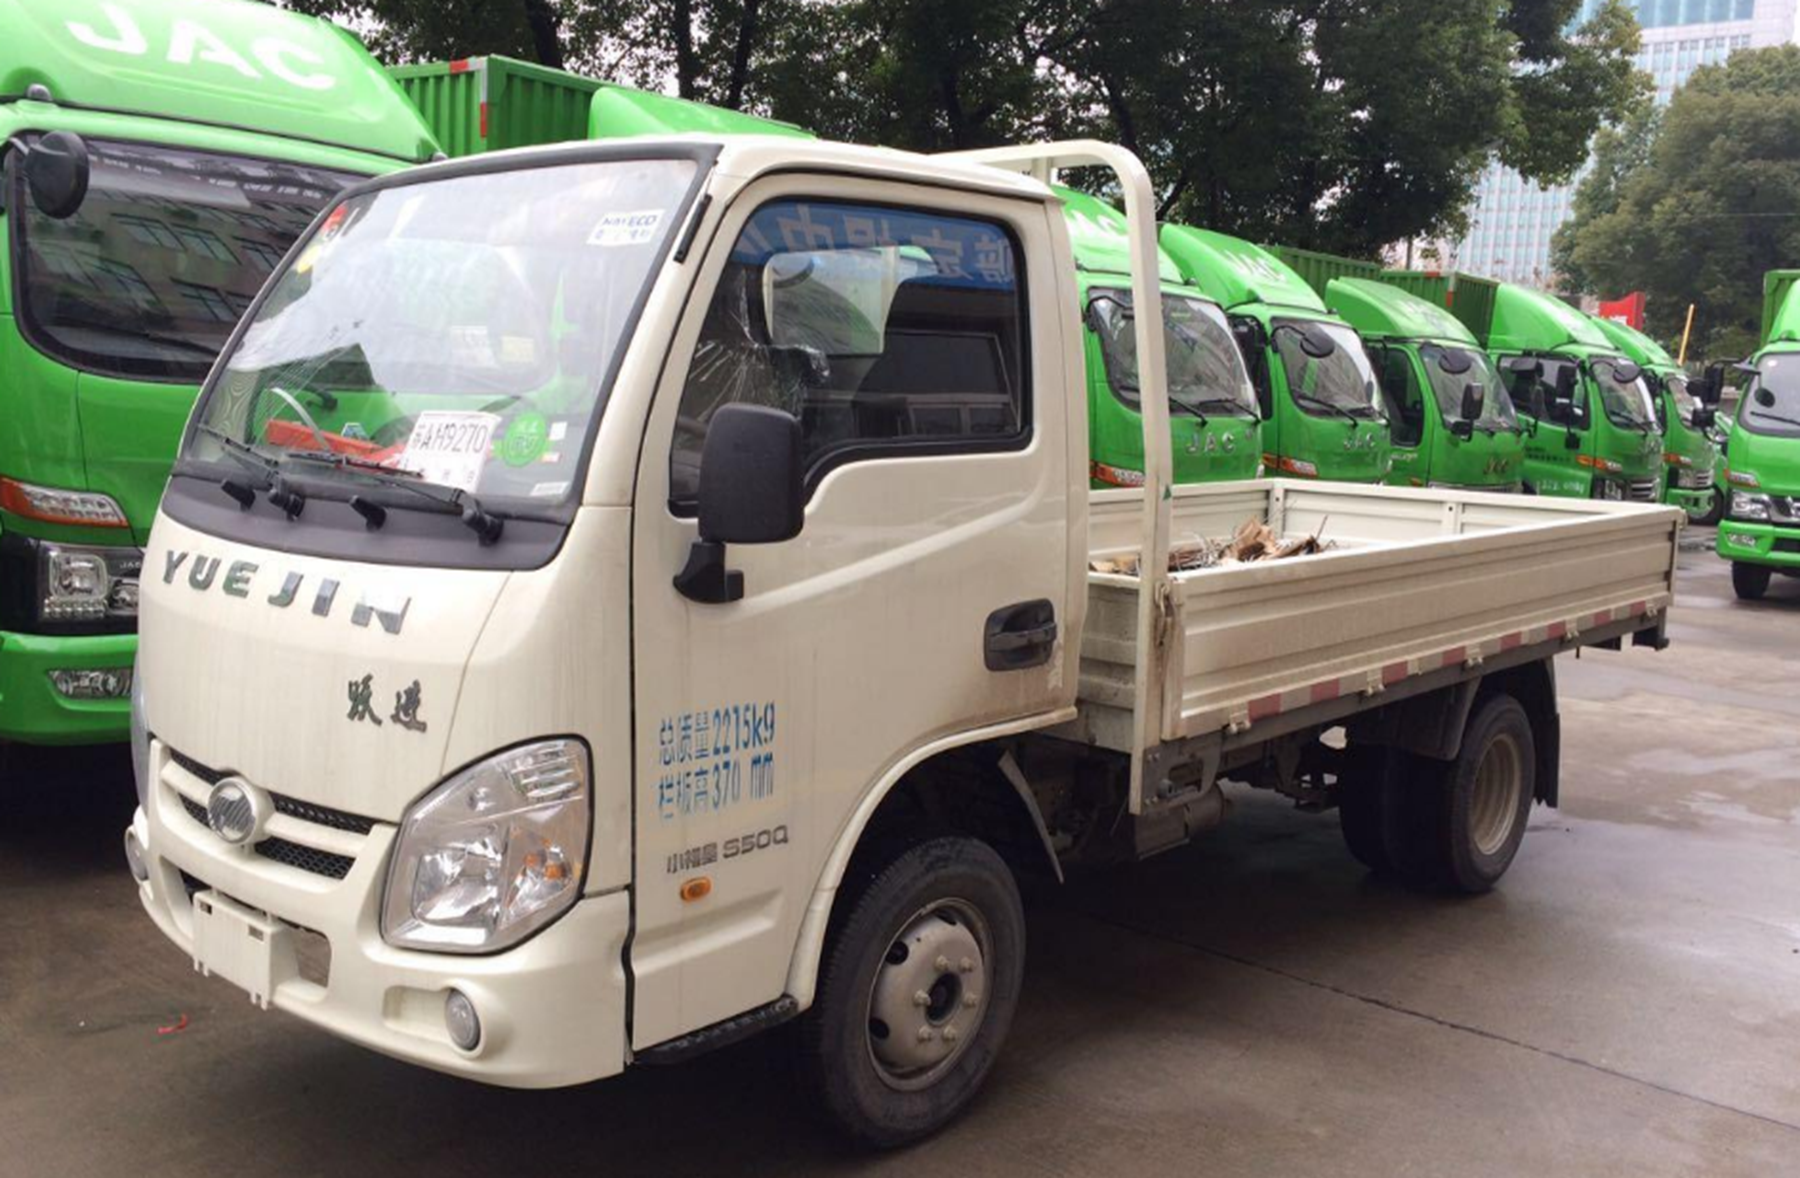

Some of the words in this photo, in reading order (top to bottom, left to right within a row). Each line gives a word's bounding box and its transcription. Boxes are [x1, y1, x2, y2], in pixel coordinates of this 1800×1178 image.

[64, 0, 336, 90] JAC
[1185, 432, 1235, 454] JAC
[162, 551, 411, 634] YUEJIN
